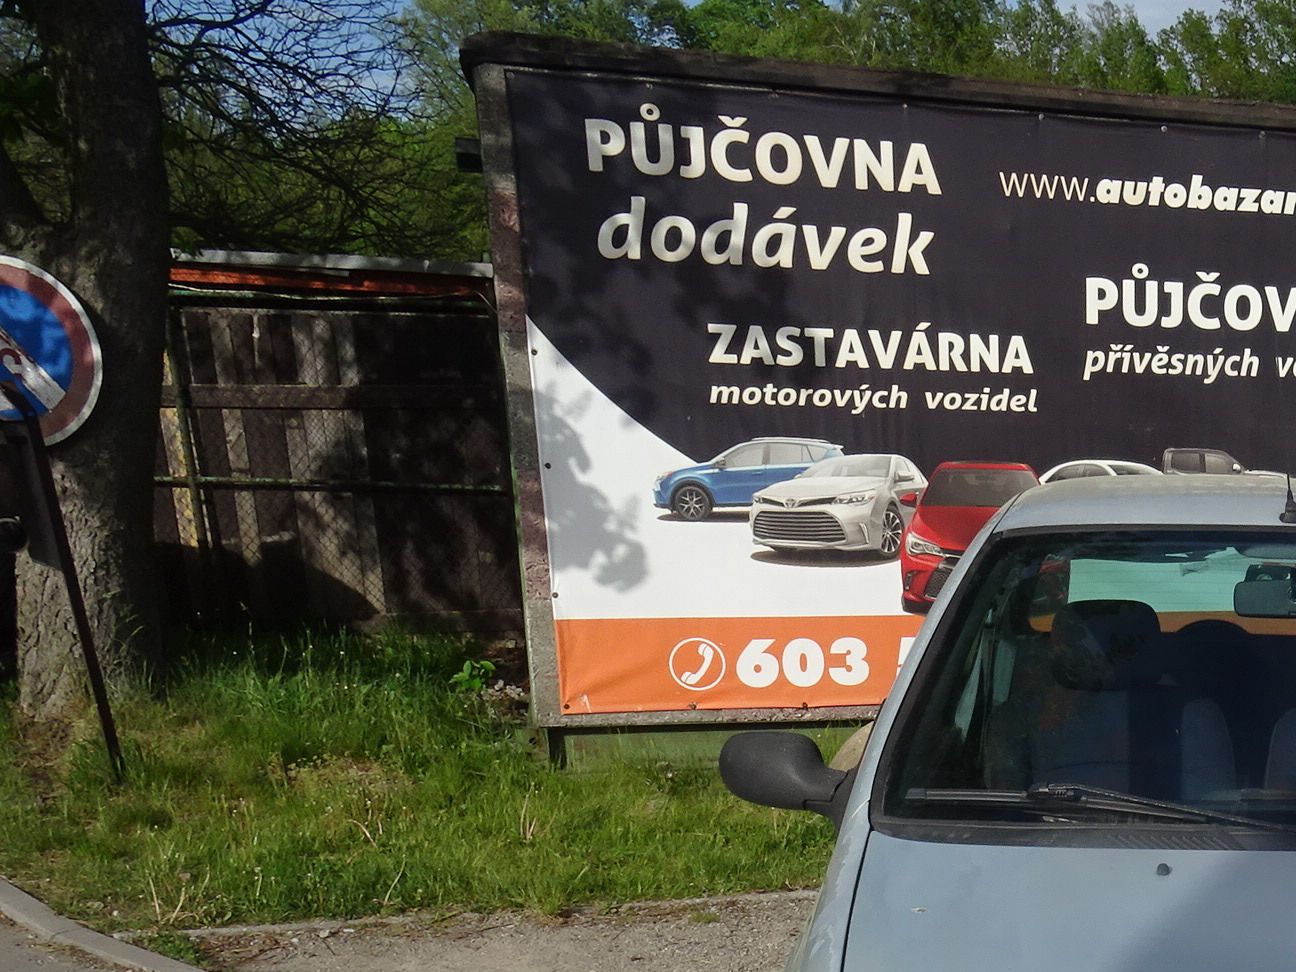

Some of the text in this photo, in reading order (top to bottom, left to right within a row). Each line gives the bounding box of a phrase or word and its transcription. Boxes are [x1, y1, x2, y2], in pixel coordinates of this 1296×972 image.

[584, 103, 943, 195] PŮJČOVNA
[597, 196, 943, 275] dodávek
[707, 322, 1034, 374] ZASTAVÁRNA
[1082, 344, 1260, 384] přívěsných
[709, 384, 1038, 414] motorových vozidel
[735, 637, 870, 688] 603
